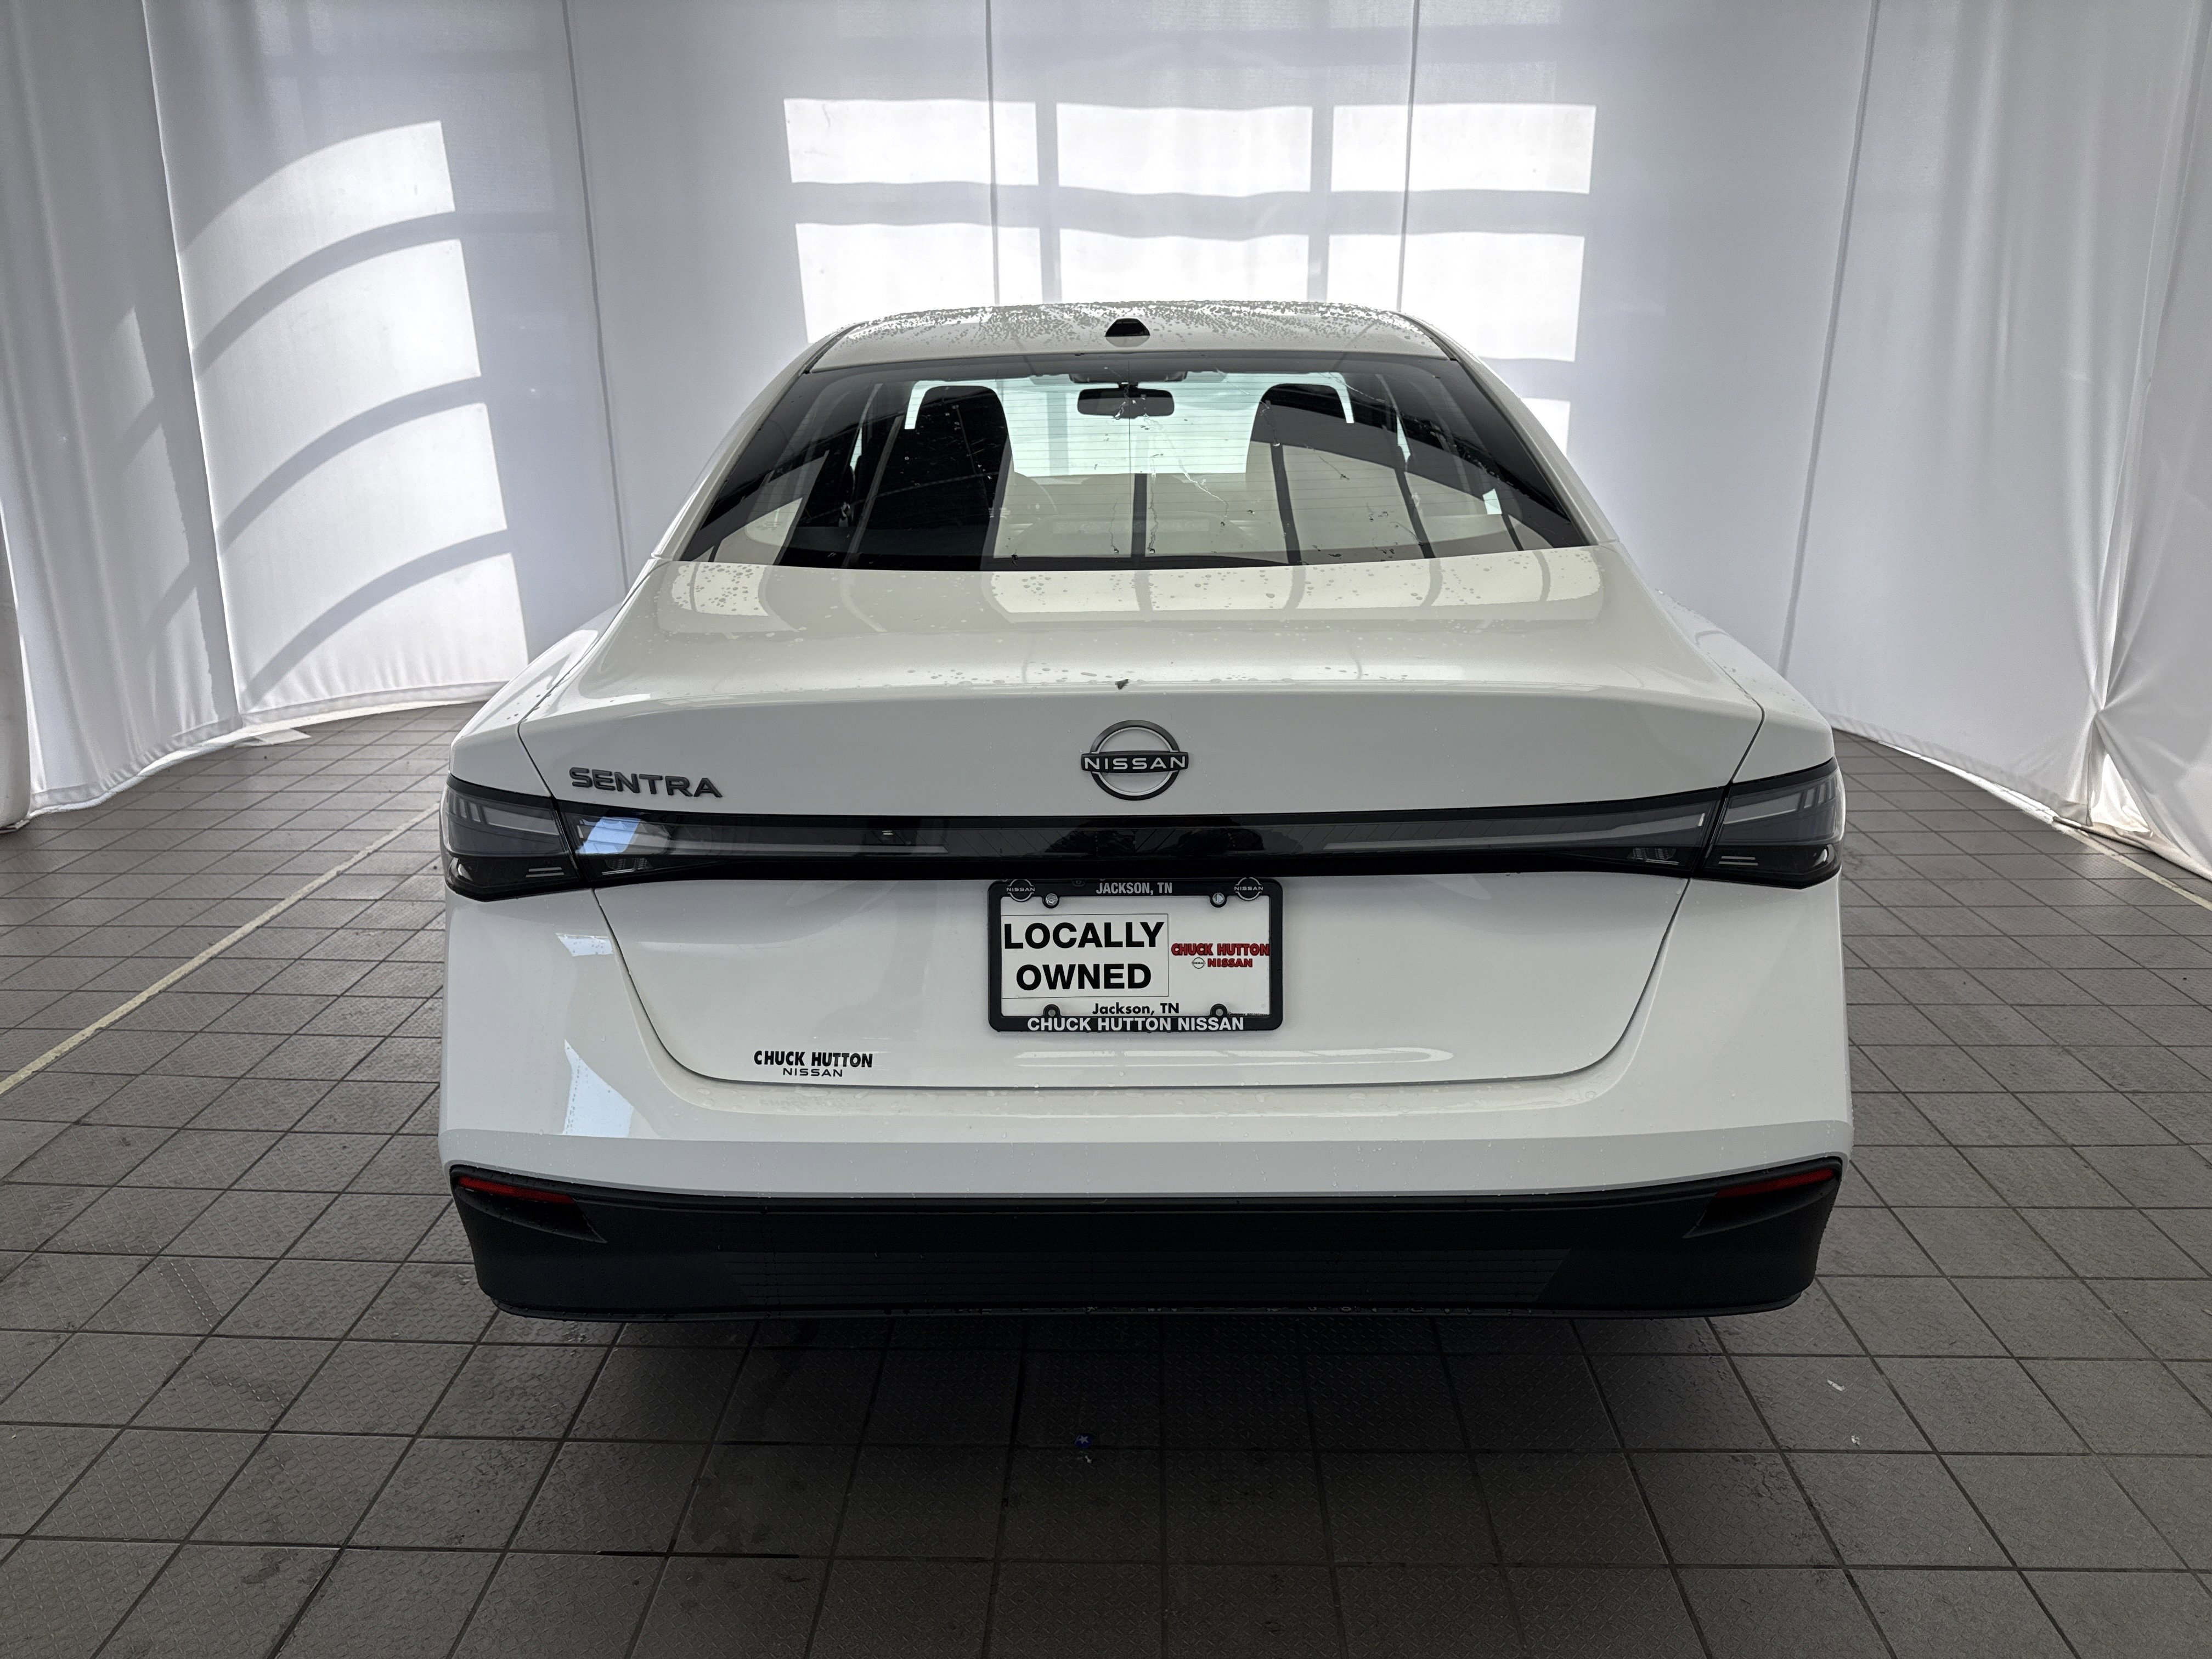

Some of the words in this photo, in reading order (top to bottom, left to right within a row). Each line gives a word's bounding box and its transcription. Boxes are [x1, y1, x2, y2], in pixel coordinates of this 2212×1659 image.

[1084, 756, 1186, 770] NISSAN
[569, 767, 723, 798] SENTRA
[1096, 882, 1153, 895] JACKSON,
[1157, 882, 1172, 894] TN
[1004, 922, 1164, 949] LOCALLY
[1171, 943, 1214, 956] CHUCK
[1217, 943, 1270, 956] HUTTON
[1207, 958, 1252, 967] NISSAN
[1016, 963, 1152, 990] OWNED
[1092, 1002, 1155, 1014] Jackson,
[1160, 1003, 1180, 1014] TN
[1027, 1017, 1091, 1031] CHUCK
[1097, 1017, 1171, 1031] HUTTON
[1178, 1017, 1244, 1030] NISSAN
[754, 1051, 805, 1066] CHUCK
[811, 1052, 873, 1068] HUTTON
[783, 1068, 843, 1077] NISSAN
